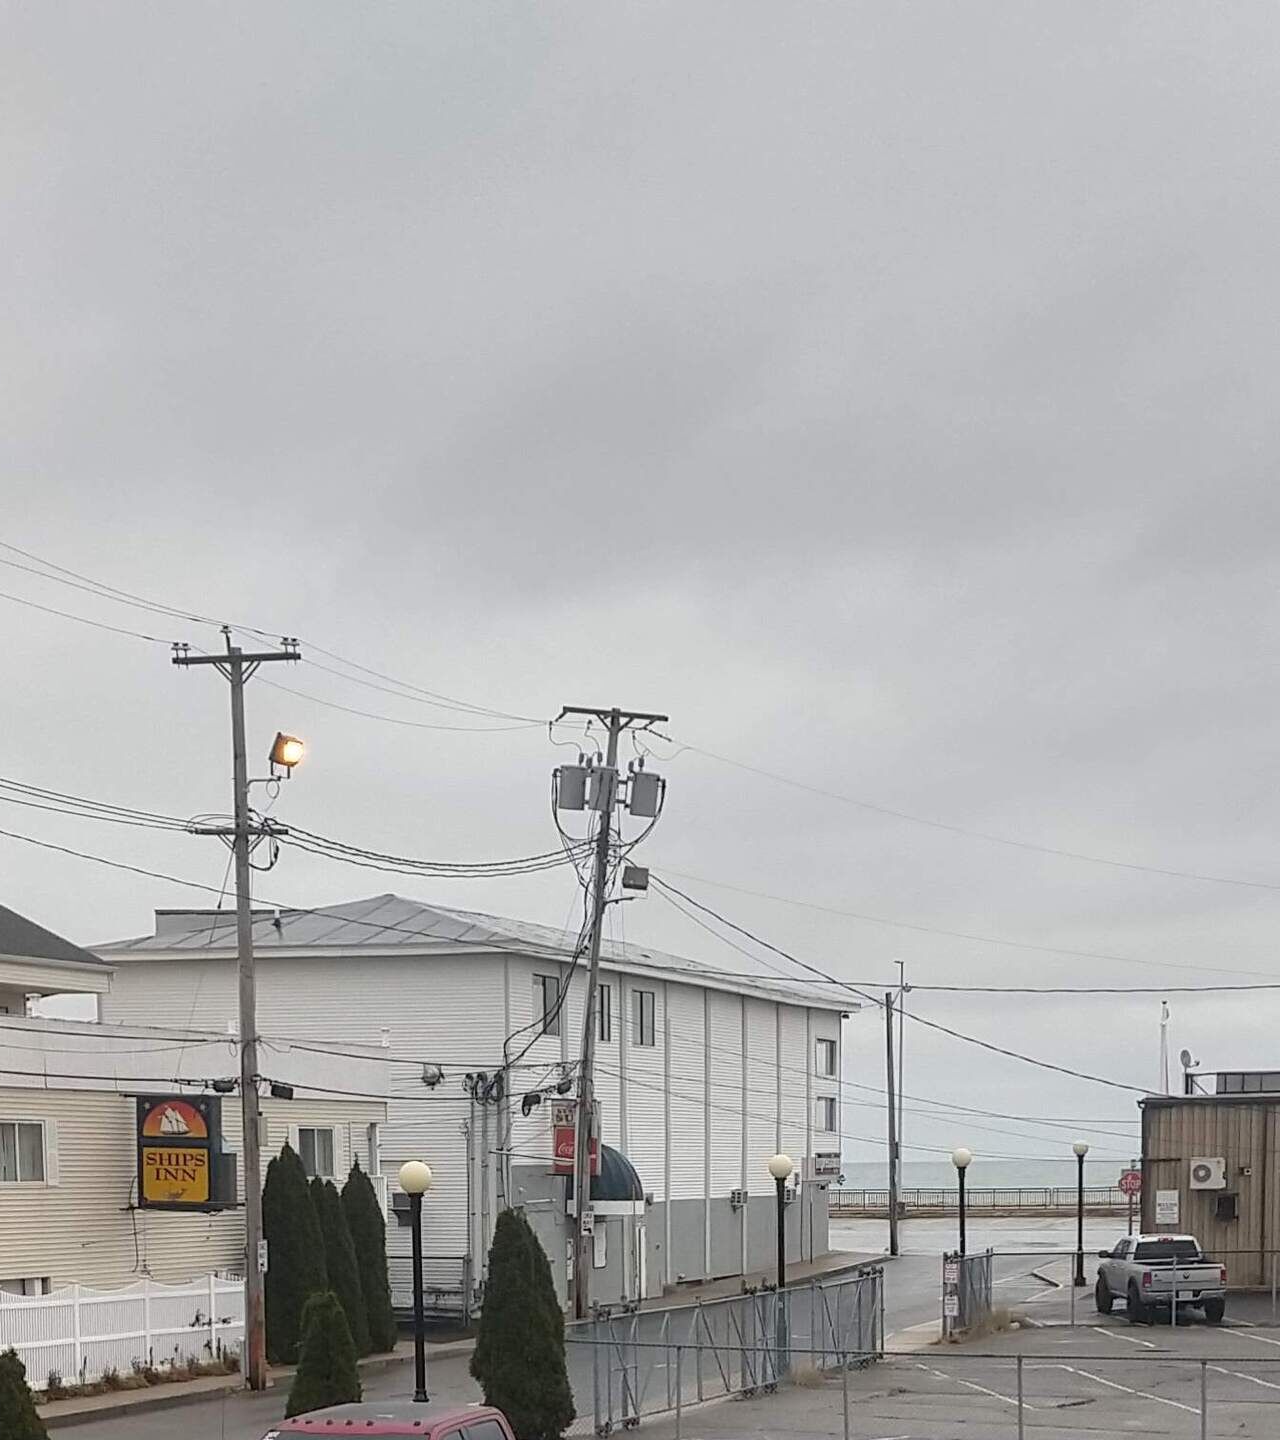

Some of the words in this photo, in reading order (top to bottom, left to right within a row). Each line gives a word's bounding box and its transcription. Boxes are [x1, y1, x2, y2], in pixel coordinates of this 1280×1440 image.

[146, 1152, 206, 1167] SHIPS
[155, 1168, 196, 1182] INN
[1121, 1179, 1142, 1189] STOP
